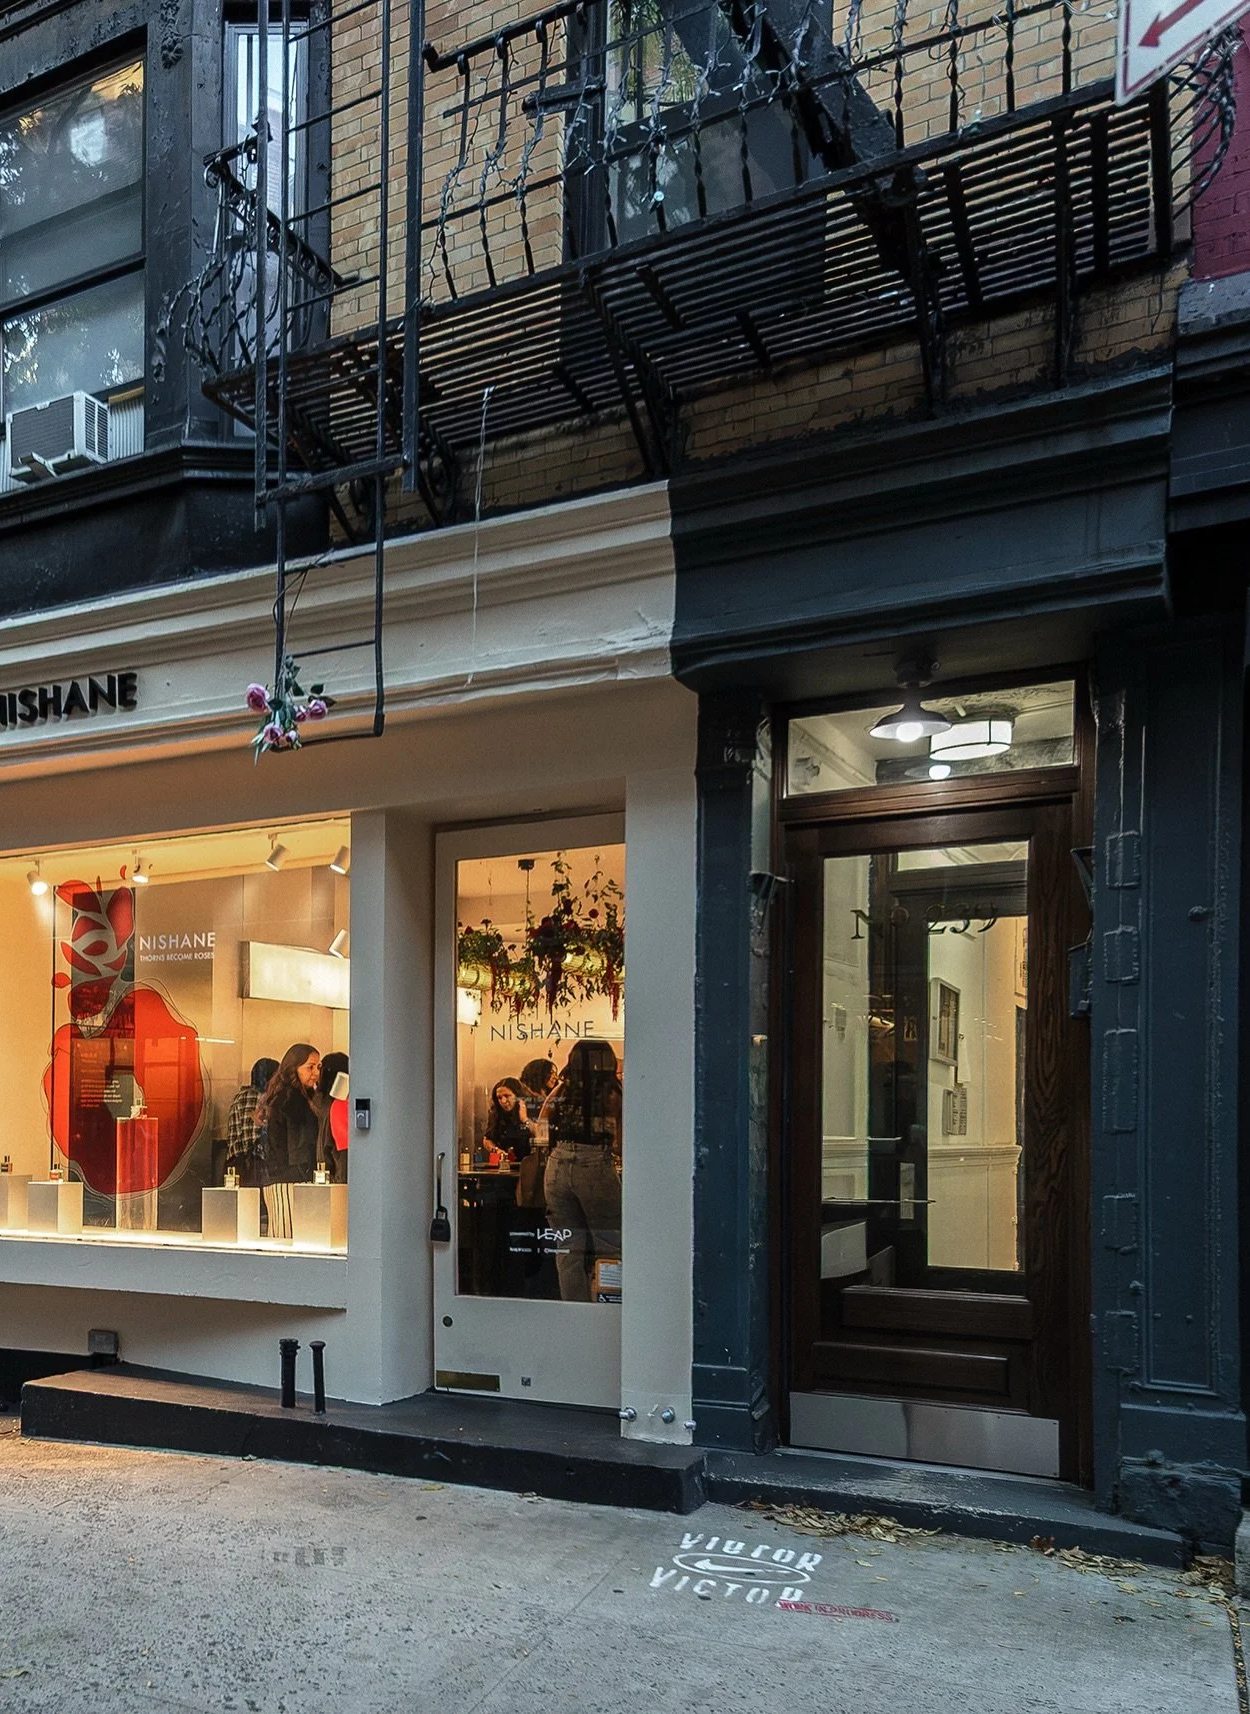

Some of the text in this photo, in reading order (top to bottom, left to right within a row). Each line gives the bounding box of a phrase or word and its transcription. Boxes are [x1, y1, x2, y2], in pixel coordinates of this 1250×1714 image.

[139, 931, 216, 951] NISHANE
[140, 951, 215, 962] THORNS BECOME ROSES
[490, 1020, 594, 1041] NISHANE
[536, 1228, 572, 1242] LEAP
